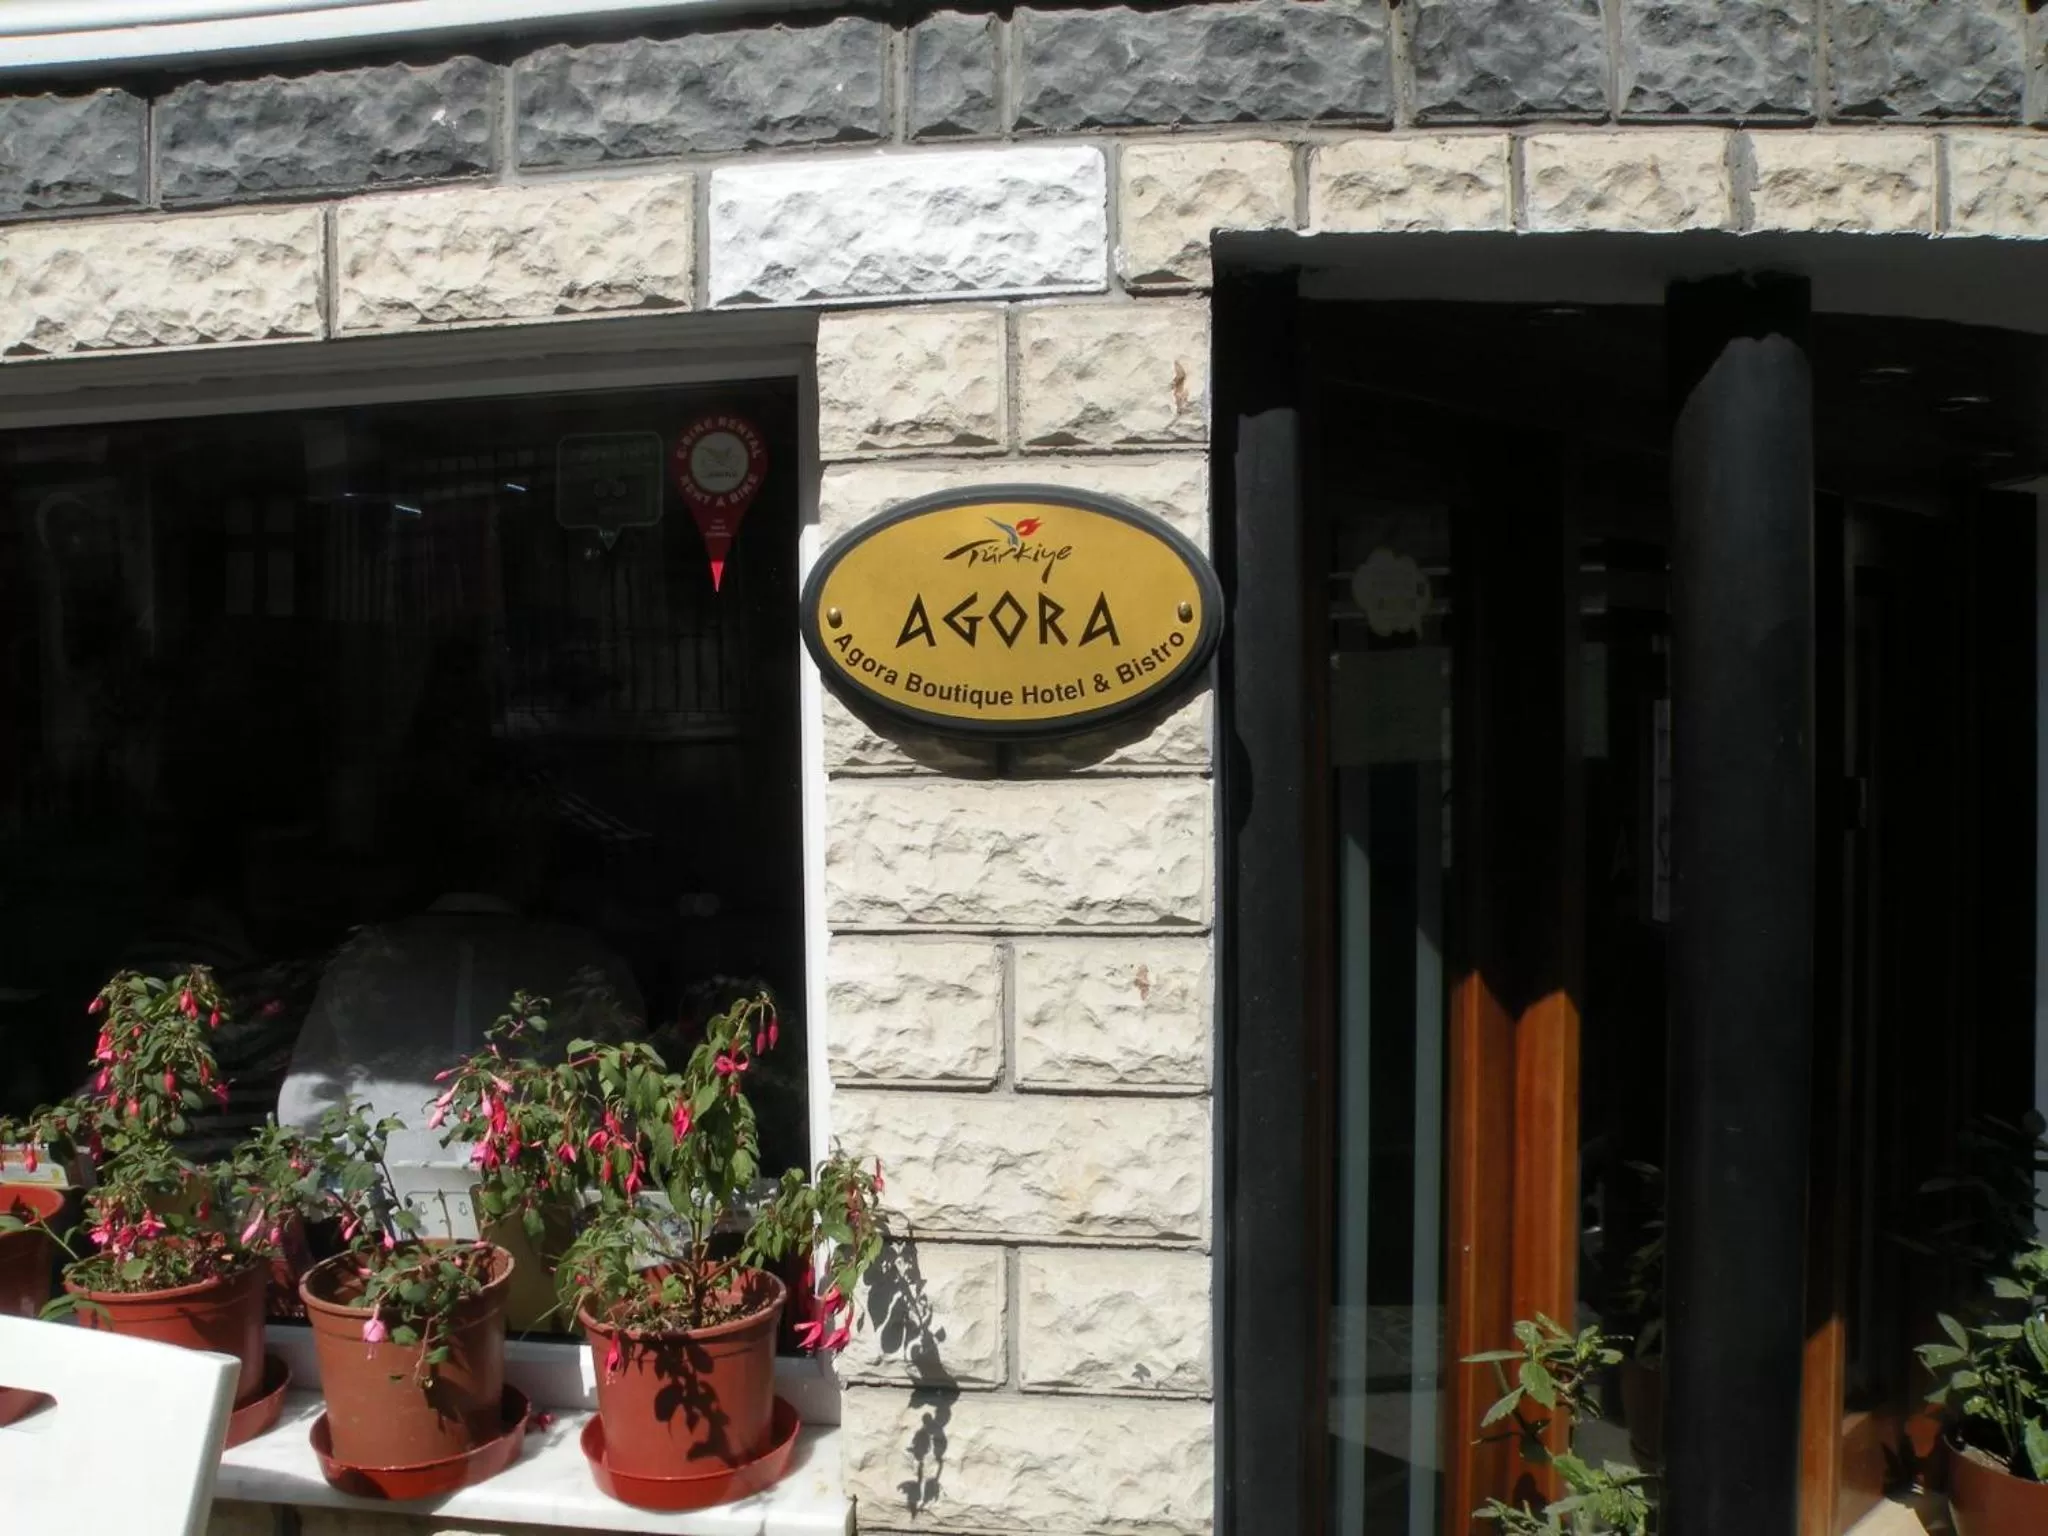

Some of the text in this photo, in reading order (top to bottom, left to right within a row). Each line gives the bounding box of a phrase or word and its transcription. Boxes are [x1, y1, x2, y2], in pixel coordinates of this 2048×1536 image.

[715, 495, 727, 508] A
[943, 538, 1073, 583] Türkiye
[895, 590, 1121, 649] AGORA
[833, 630, 1186, 710] Agora Boutique Hotel & Bistro
